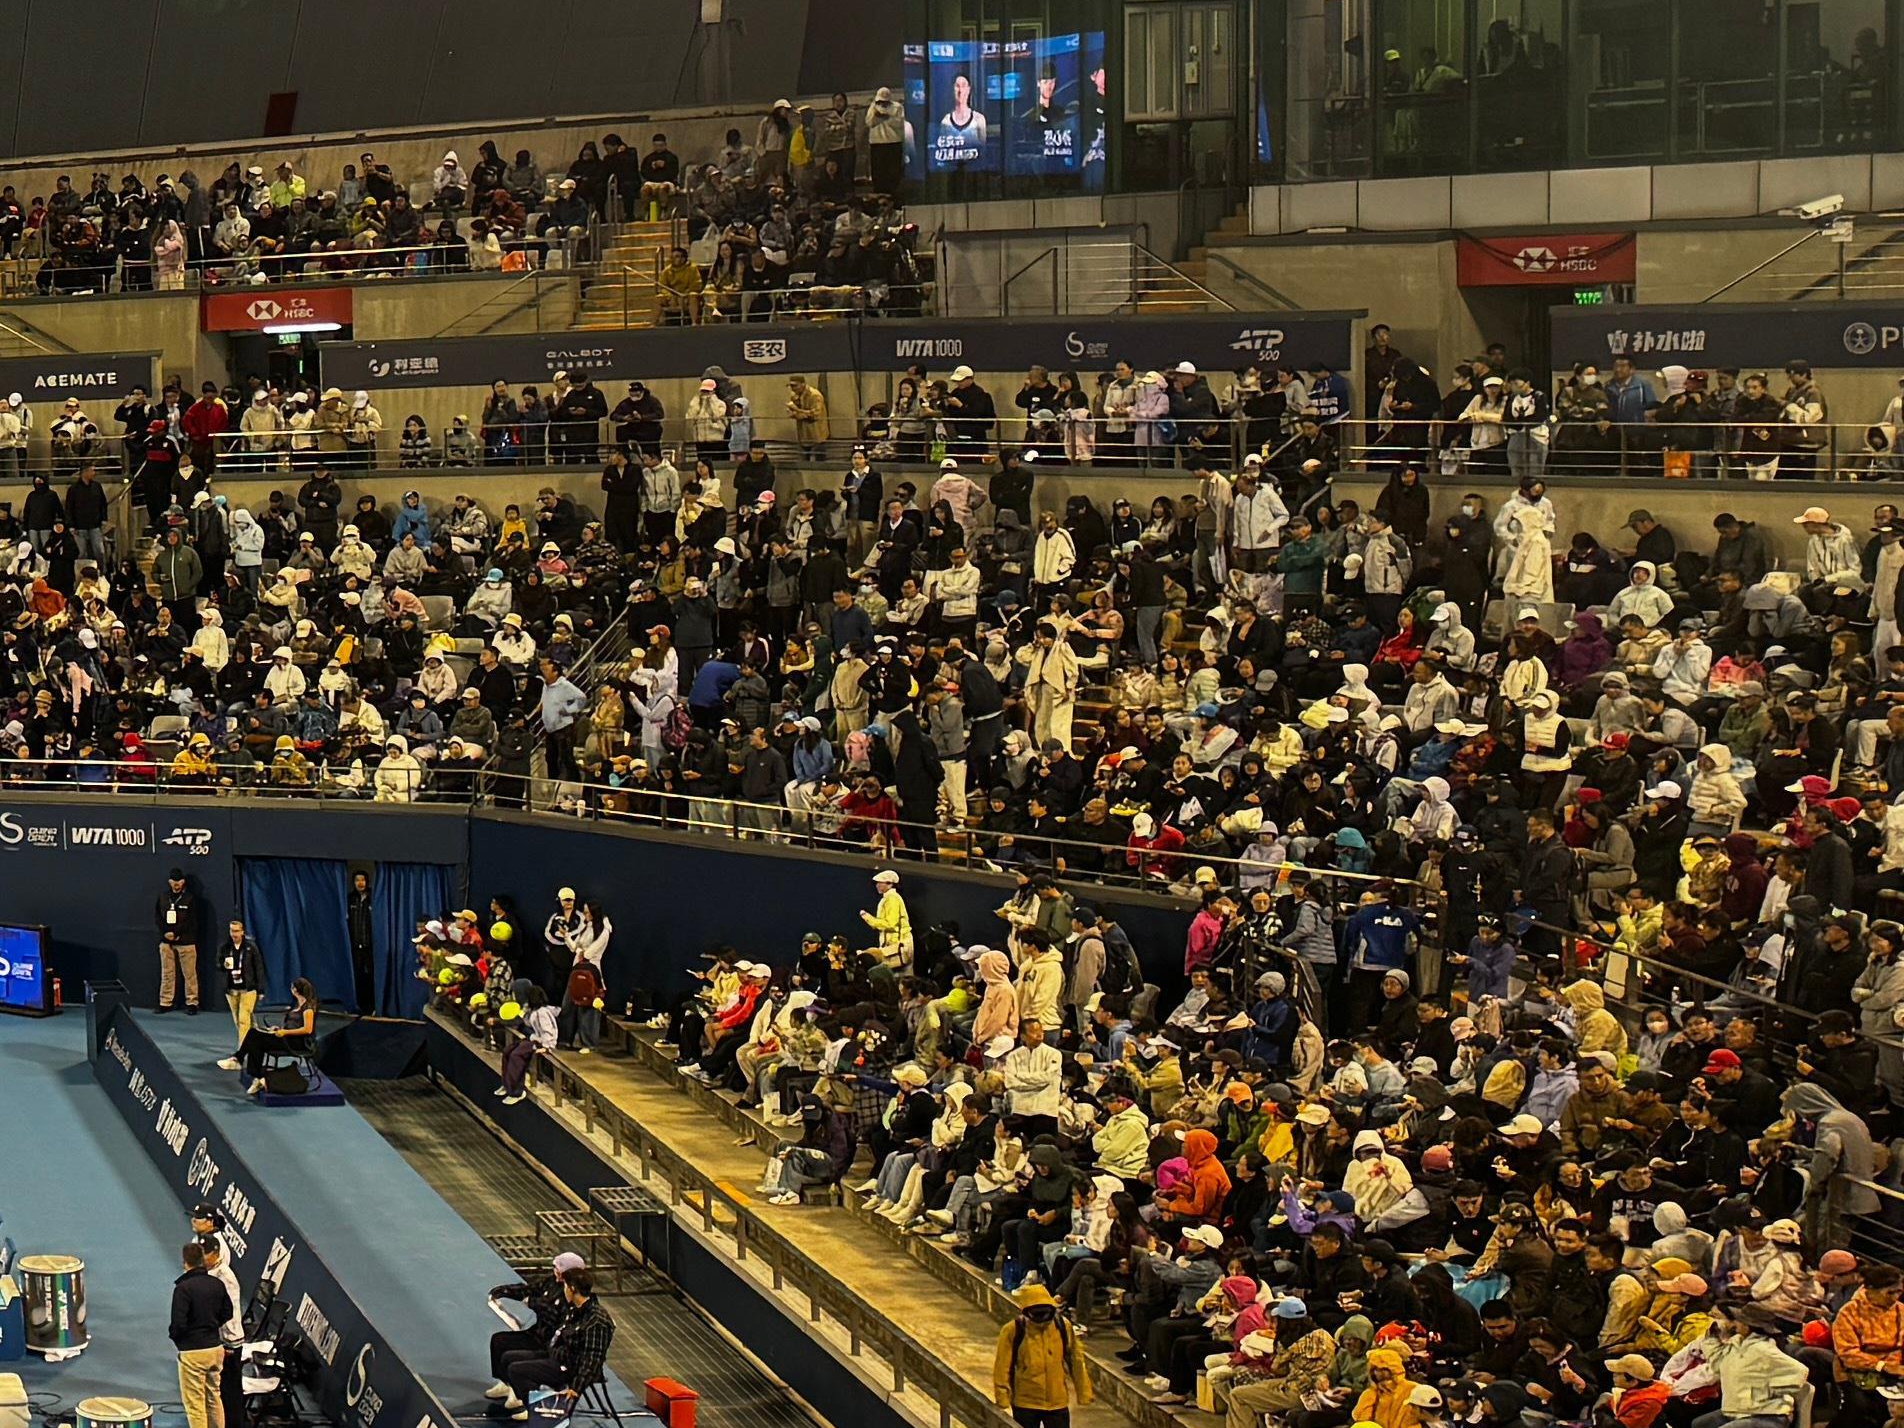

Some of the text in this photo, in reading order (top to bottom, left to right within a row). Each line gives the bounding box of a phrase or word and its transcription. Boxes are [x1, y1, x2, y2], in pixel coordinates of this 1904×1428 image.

[1228, 329, 1284, 350] ATP
[1881, 326, 1904, 348] P
[896, 339, 962, 357] WTA 1000
[1258, 350, 1280, 361] 500
[34, 372, 117, 388] ACEMATE
[71, 827, 145, 847] WTA 1000
[161, 828, 212, 846] ATP
[189, 845, 210, 856] 500
